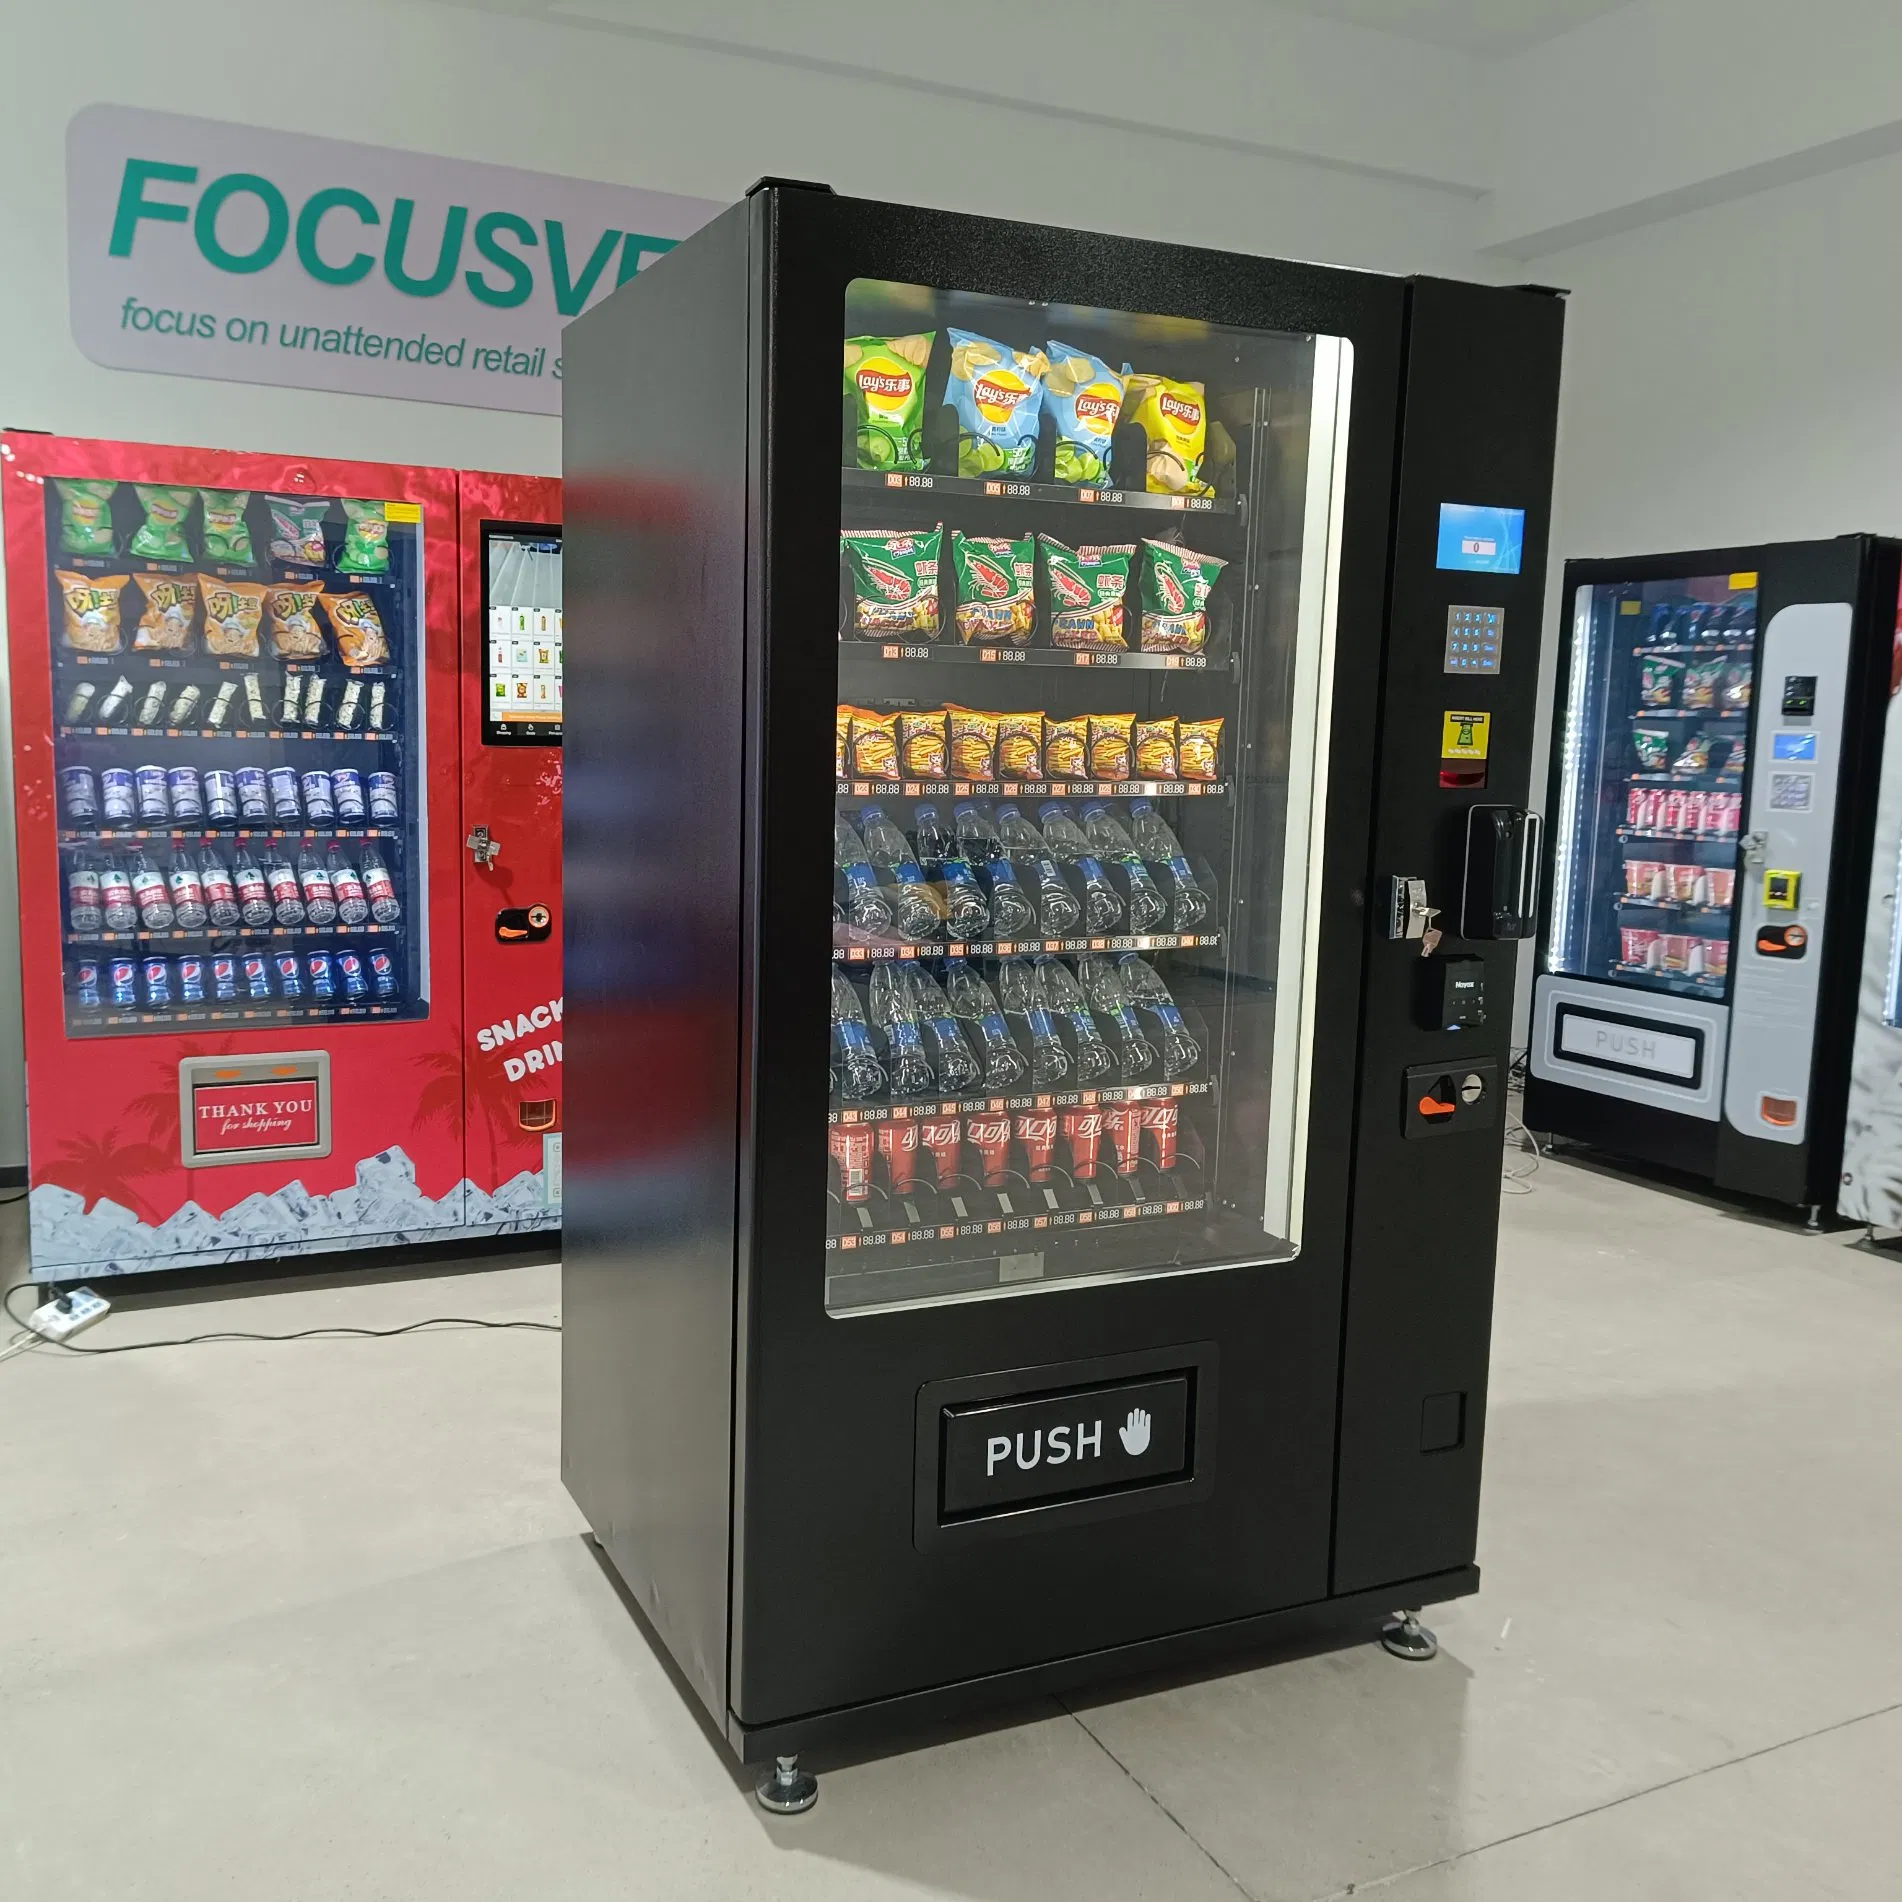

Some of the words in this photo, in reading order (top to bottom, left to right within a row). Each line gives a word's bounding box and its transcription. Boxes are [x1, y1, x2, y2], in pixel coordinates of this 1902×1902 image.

[121, 297, 217, 339] focus
[226, 317, 269, 345] on
[279, 324, 466, 368] unattended
[472, 345, 547, 378] retail
[1595, 1030, 1656, 1061] PUSH
[199, 1102, 269, 1119] THANK
[273, 1100, 312, 1113] YOU
[220, 1118, 239, 1135] for
[242, 1117, 292, 1133] shopping
[986, 1420, 1102, 1476] PUSH
